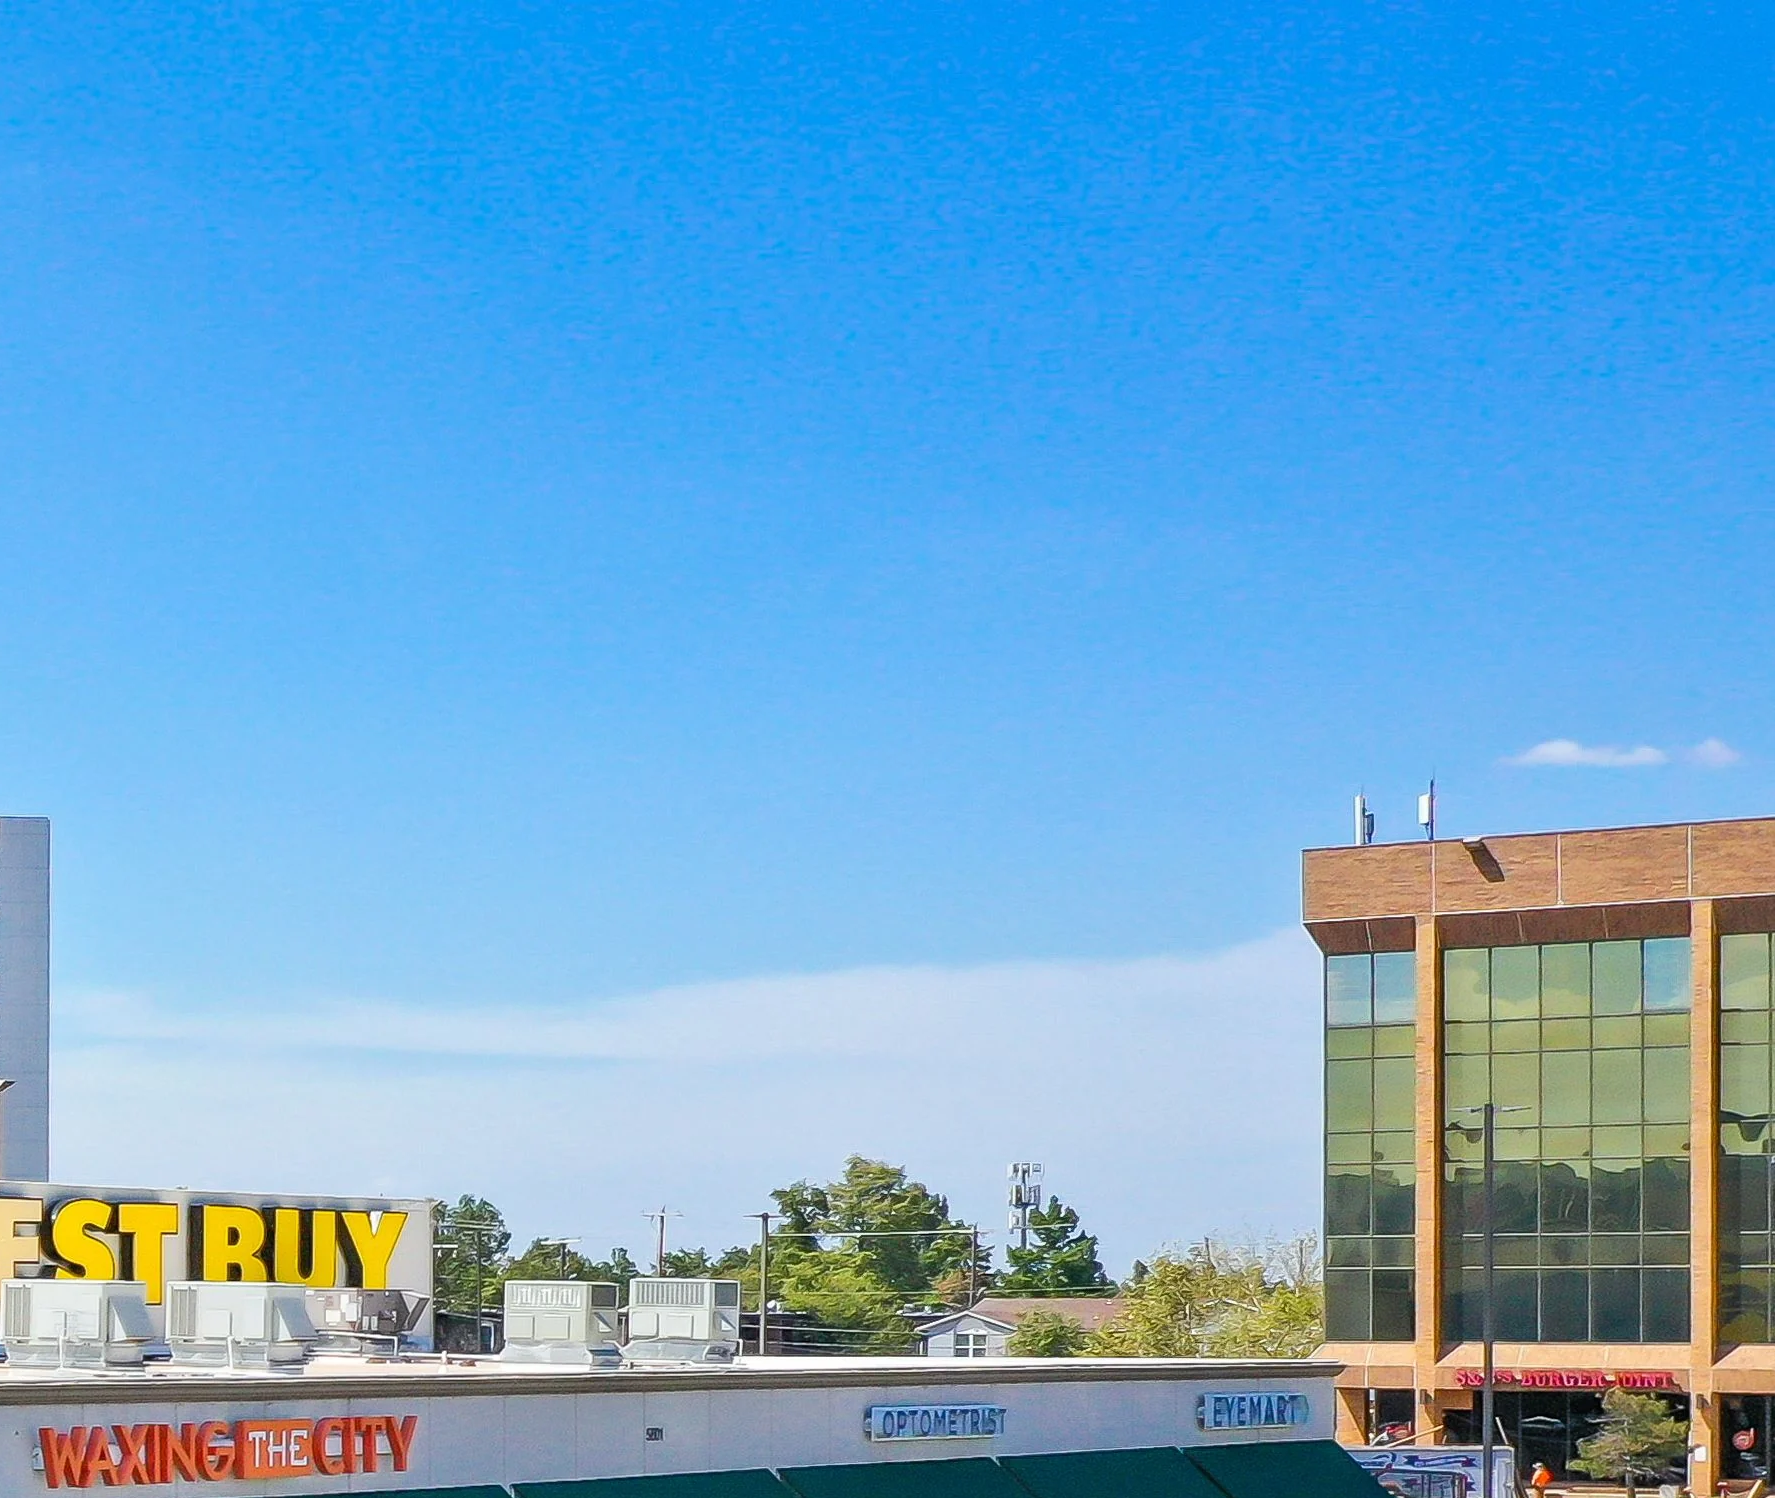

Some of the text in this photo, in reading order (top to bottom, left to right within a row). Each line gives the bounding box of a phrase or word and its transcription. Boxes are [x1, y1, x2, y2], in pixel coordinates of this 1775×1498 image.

[192, 1203, 408, 1290] BUY
[1521, 1370, 1604, 1387] BURGER
[883, 1408, 1007, 1436] OPTOMETRIST
[1214, 1395, 1295, 1428] EYEMART
[38, 1415, 418, 1489] WAXING THE CITY
